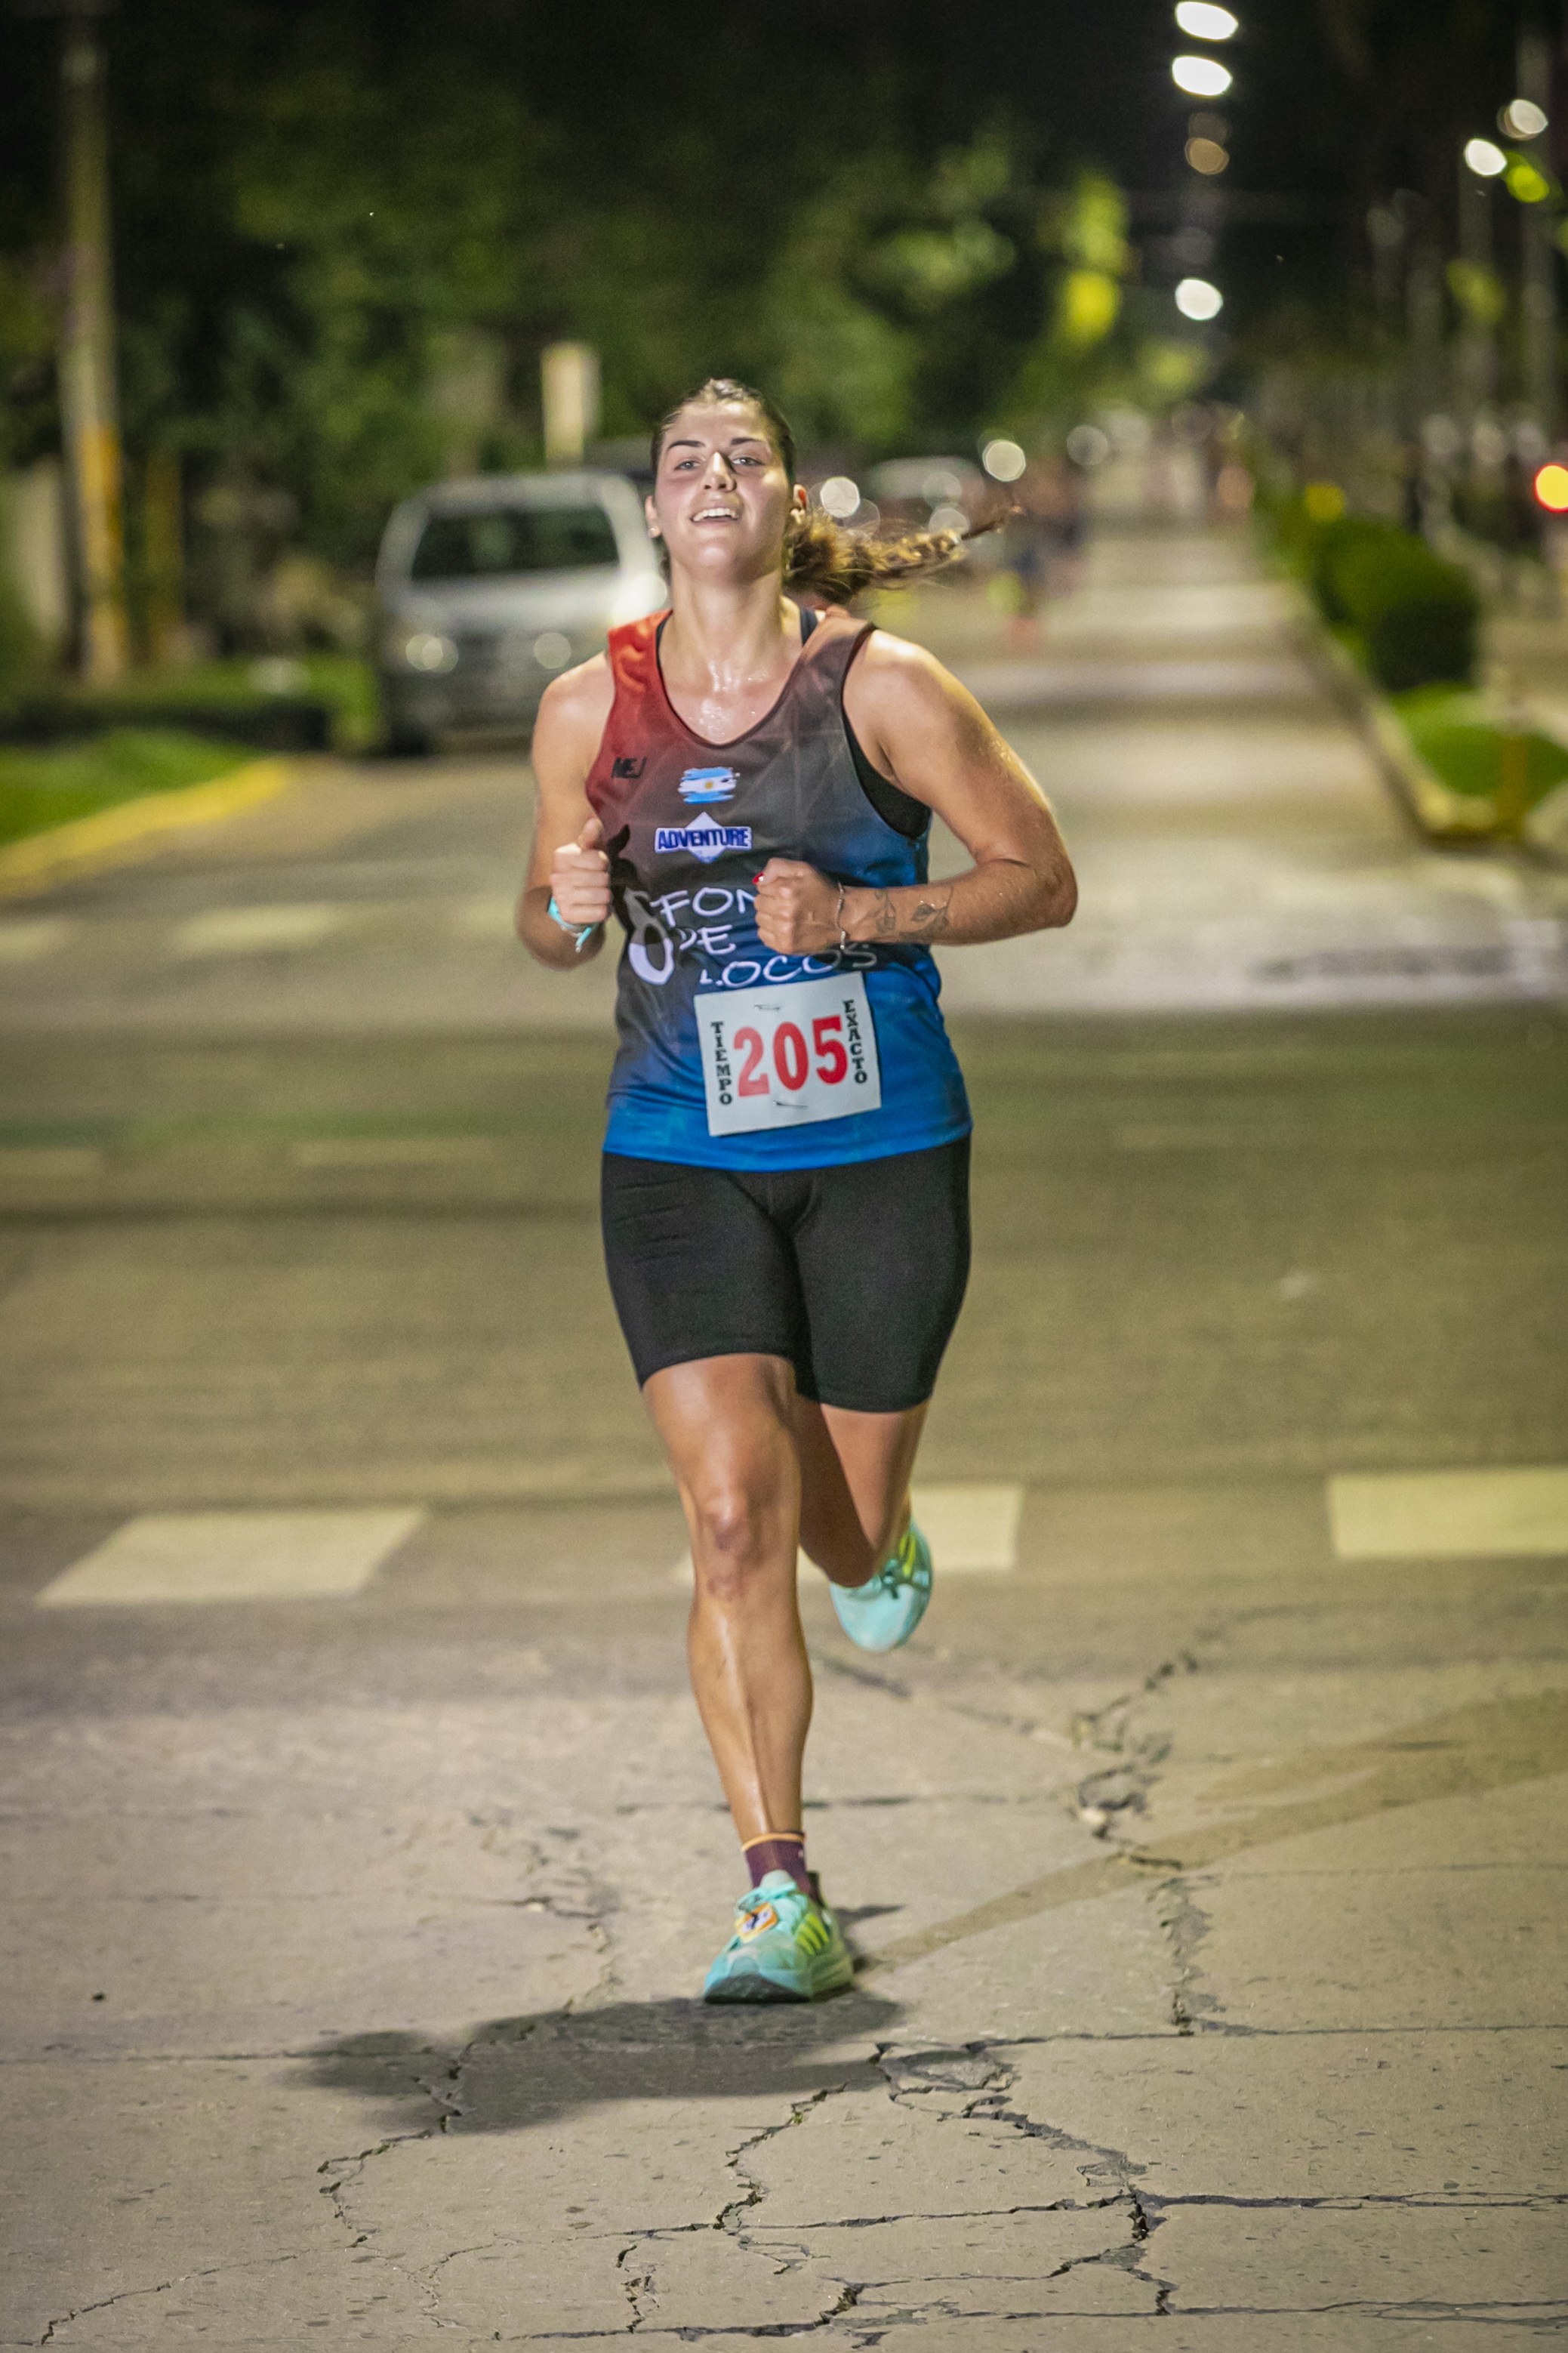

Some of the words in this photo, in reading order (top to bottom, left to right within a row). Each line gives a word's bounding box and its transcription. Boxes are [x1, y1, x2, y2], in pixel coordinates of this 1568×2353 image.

[658, 828, 749, 850] ADVENTURE
[676, 924, 736, 955] DE
[711, 1021, 732, 1106] TIEMPO
[732, 1013, 849, 1098] 205
[843, 999, 867, 1084] EXACTO
